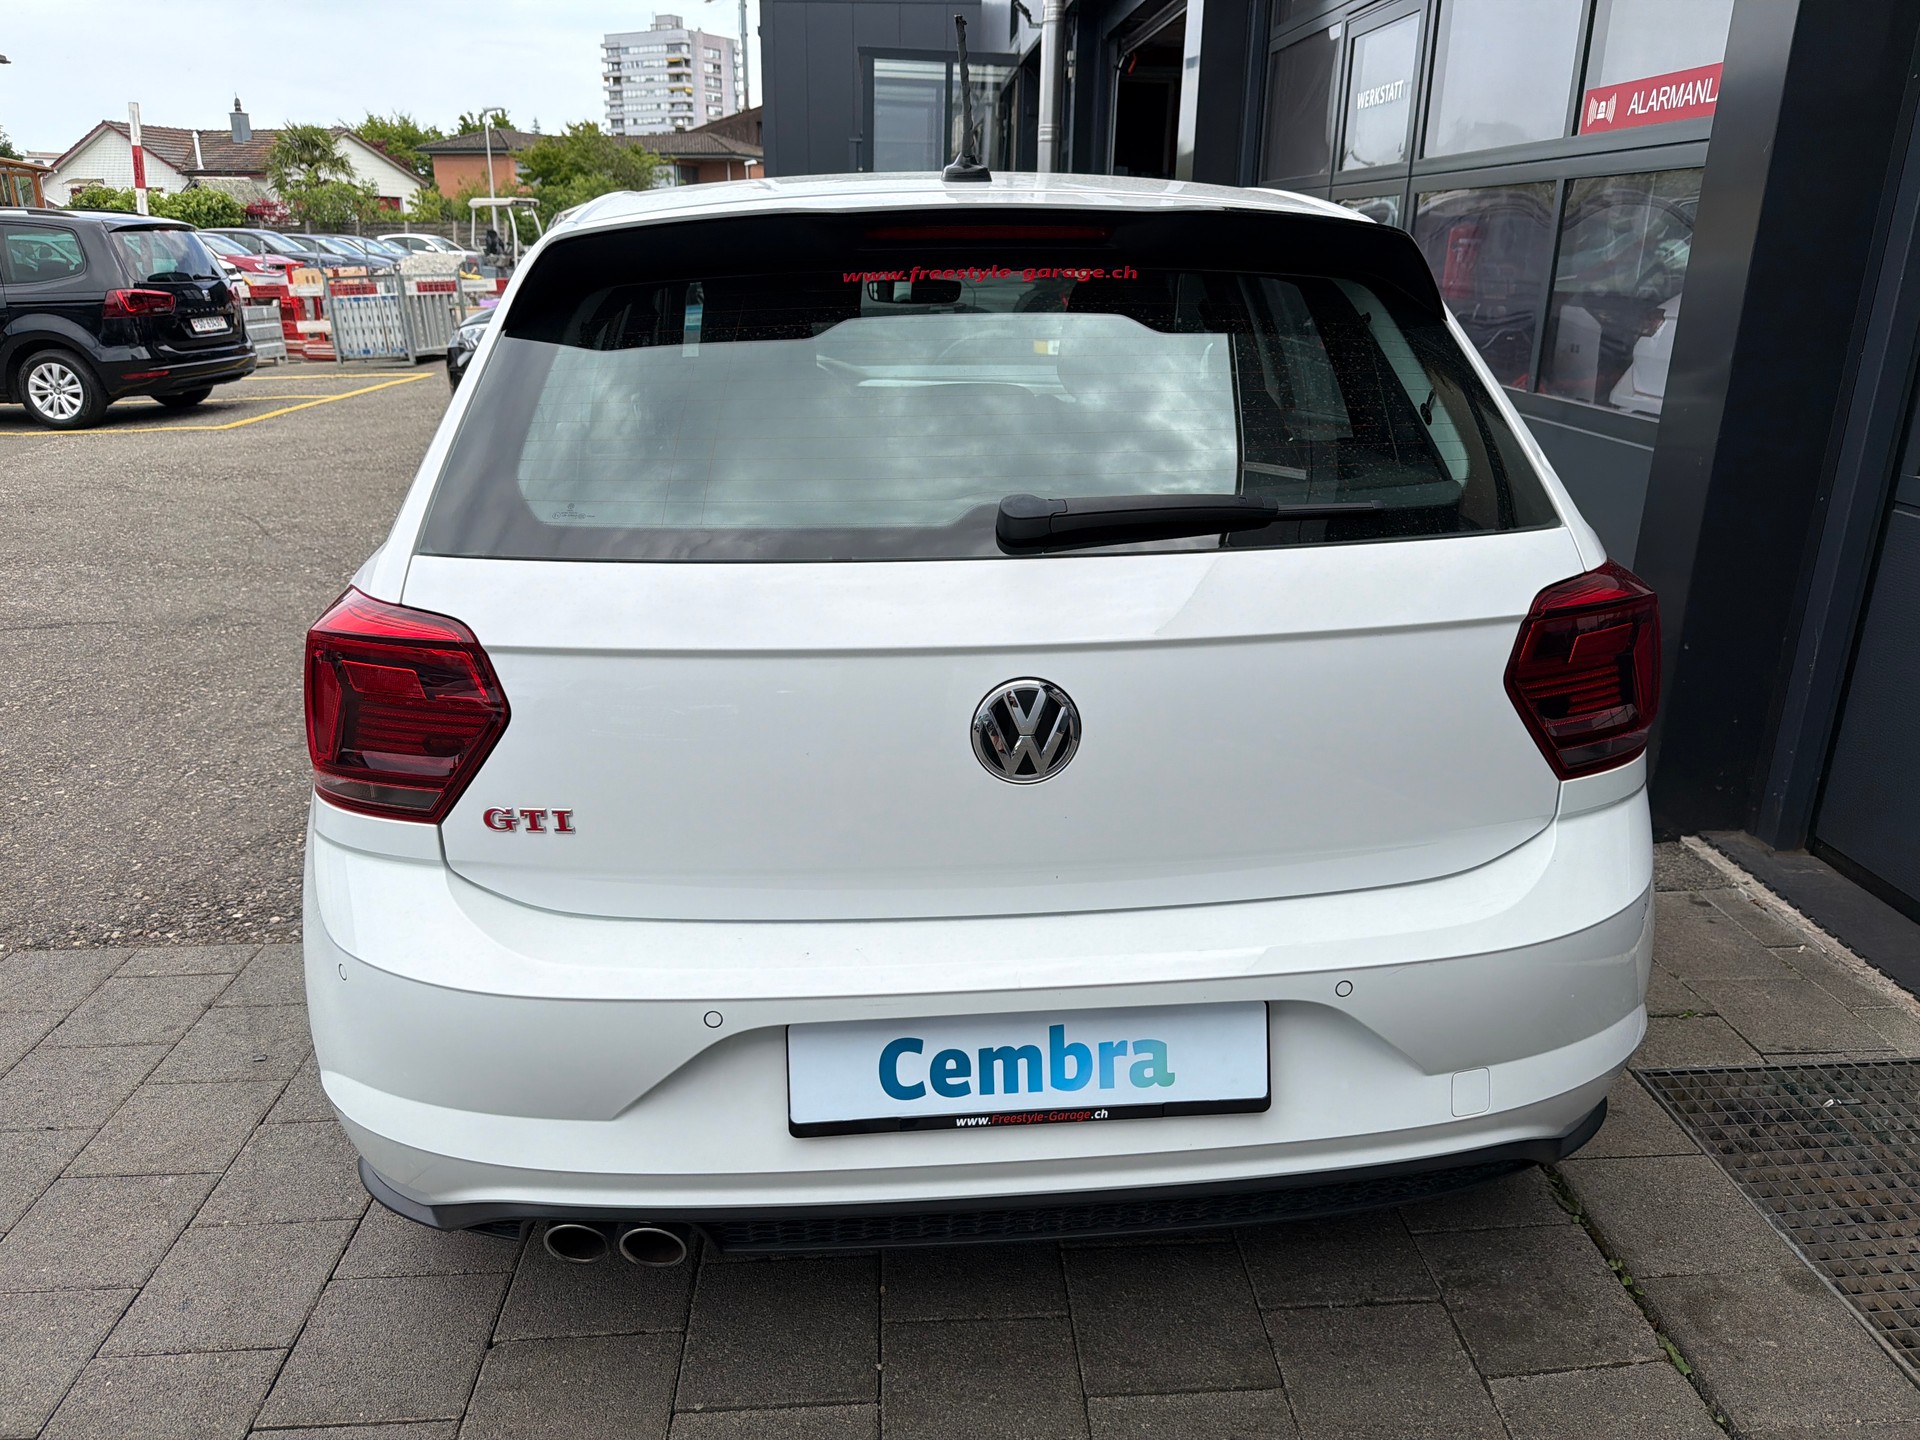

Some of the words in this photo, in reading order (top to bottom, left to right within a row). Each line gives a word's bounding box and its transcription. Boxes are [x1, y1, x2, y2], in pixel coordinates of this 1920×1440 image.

[1357, 79, 1405, 110] WERKSTATT
[843, 265, 1138, 283] www.freestyle-garage.ch
[483, 806, 576, 834] GTI
[878, 1024, 1176, 1101] Cembra
[955, 1108, 1109, 1127] www.Freestyle-Garage.ch
